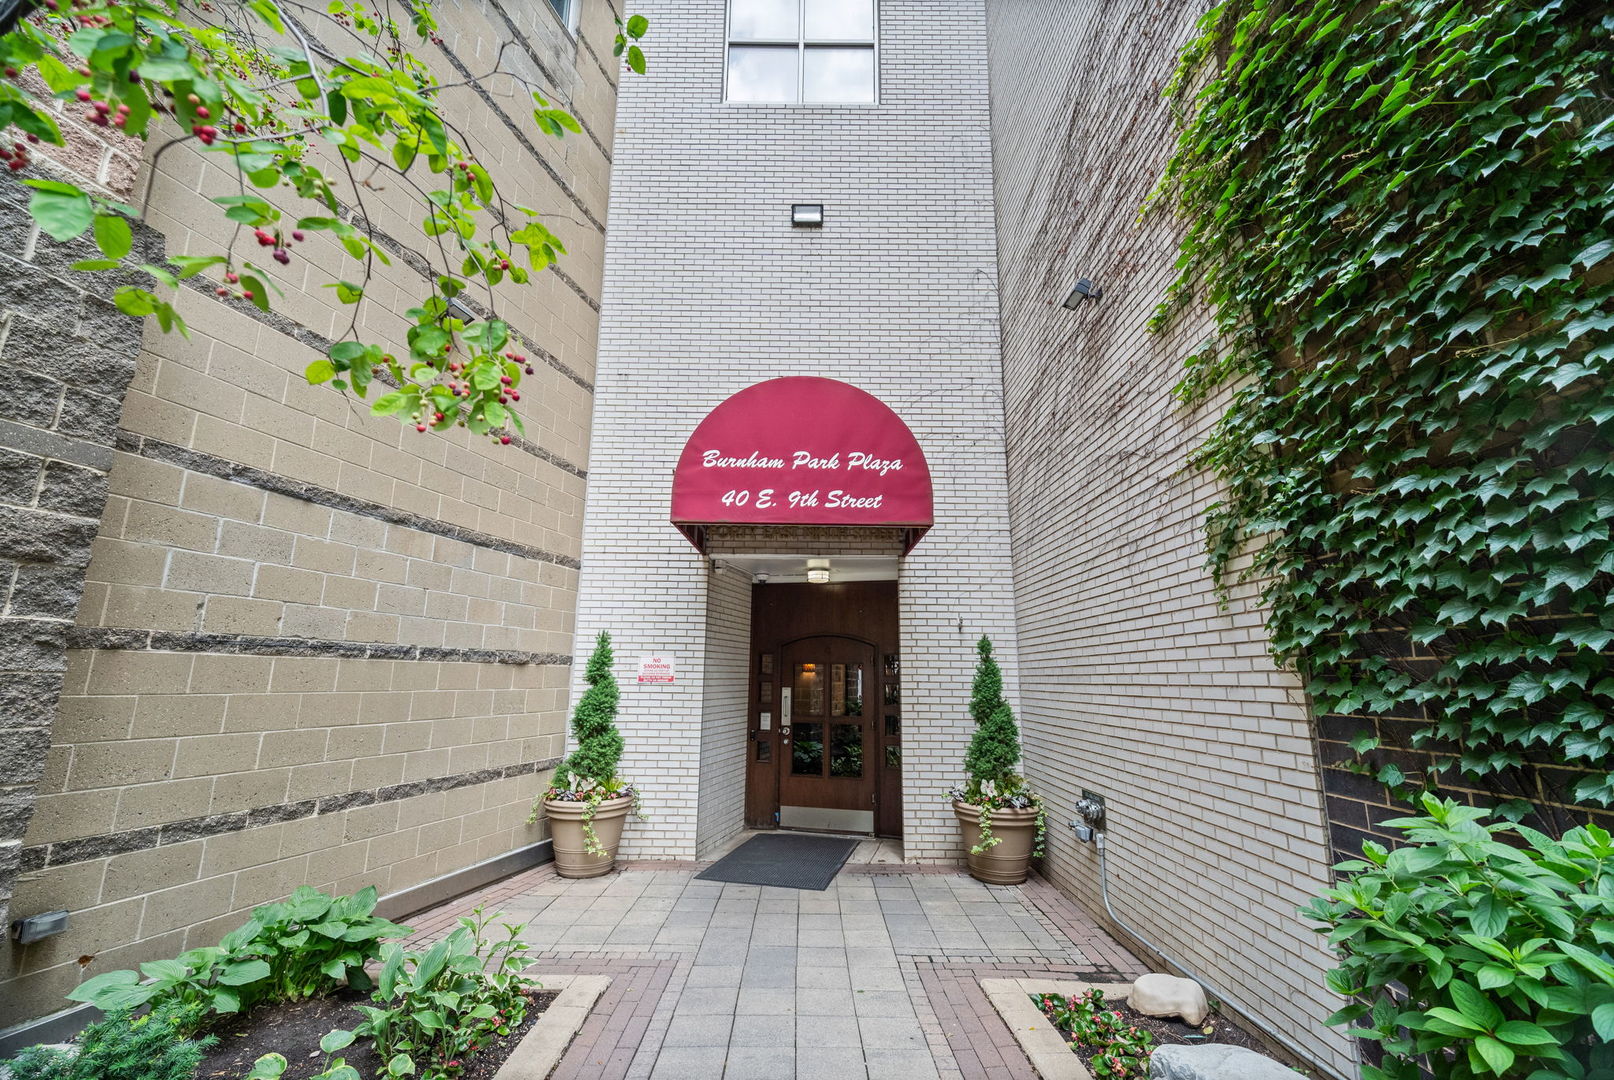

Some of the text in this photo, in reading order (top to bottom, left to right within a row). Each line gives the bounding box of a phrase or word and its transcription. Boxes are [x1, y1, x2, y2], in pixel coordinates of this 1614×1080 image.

[702, 449, 904, 476] Burnham Park Plaza
[721, 489, 883, 508] 40 E. 9th Street
